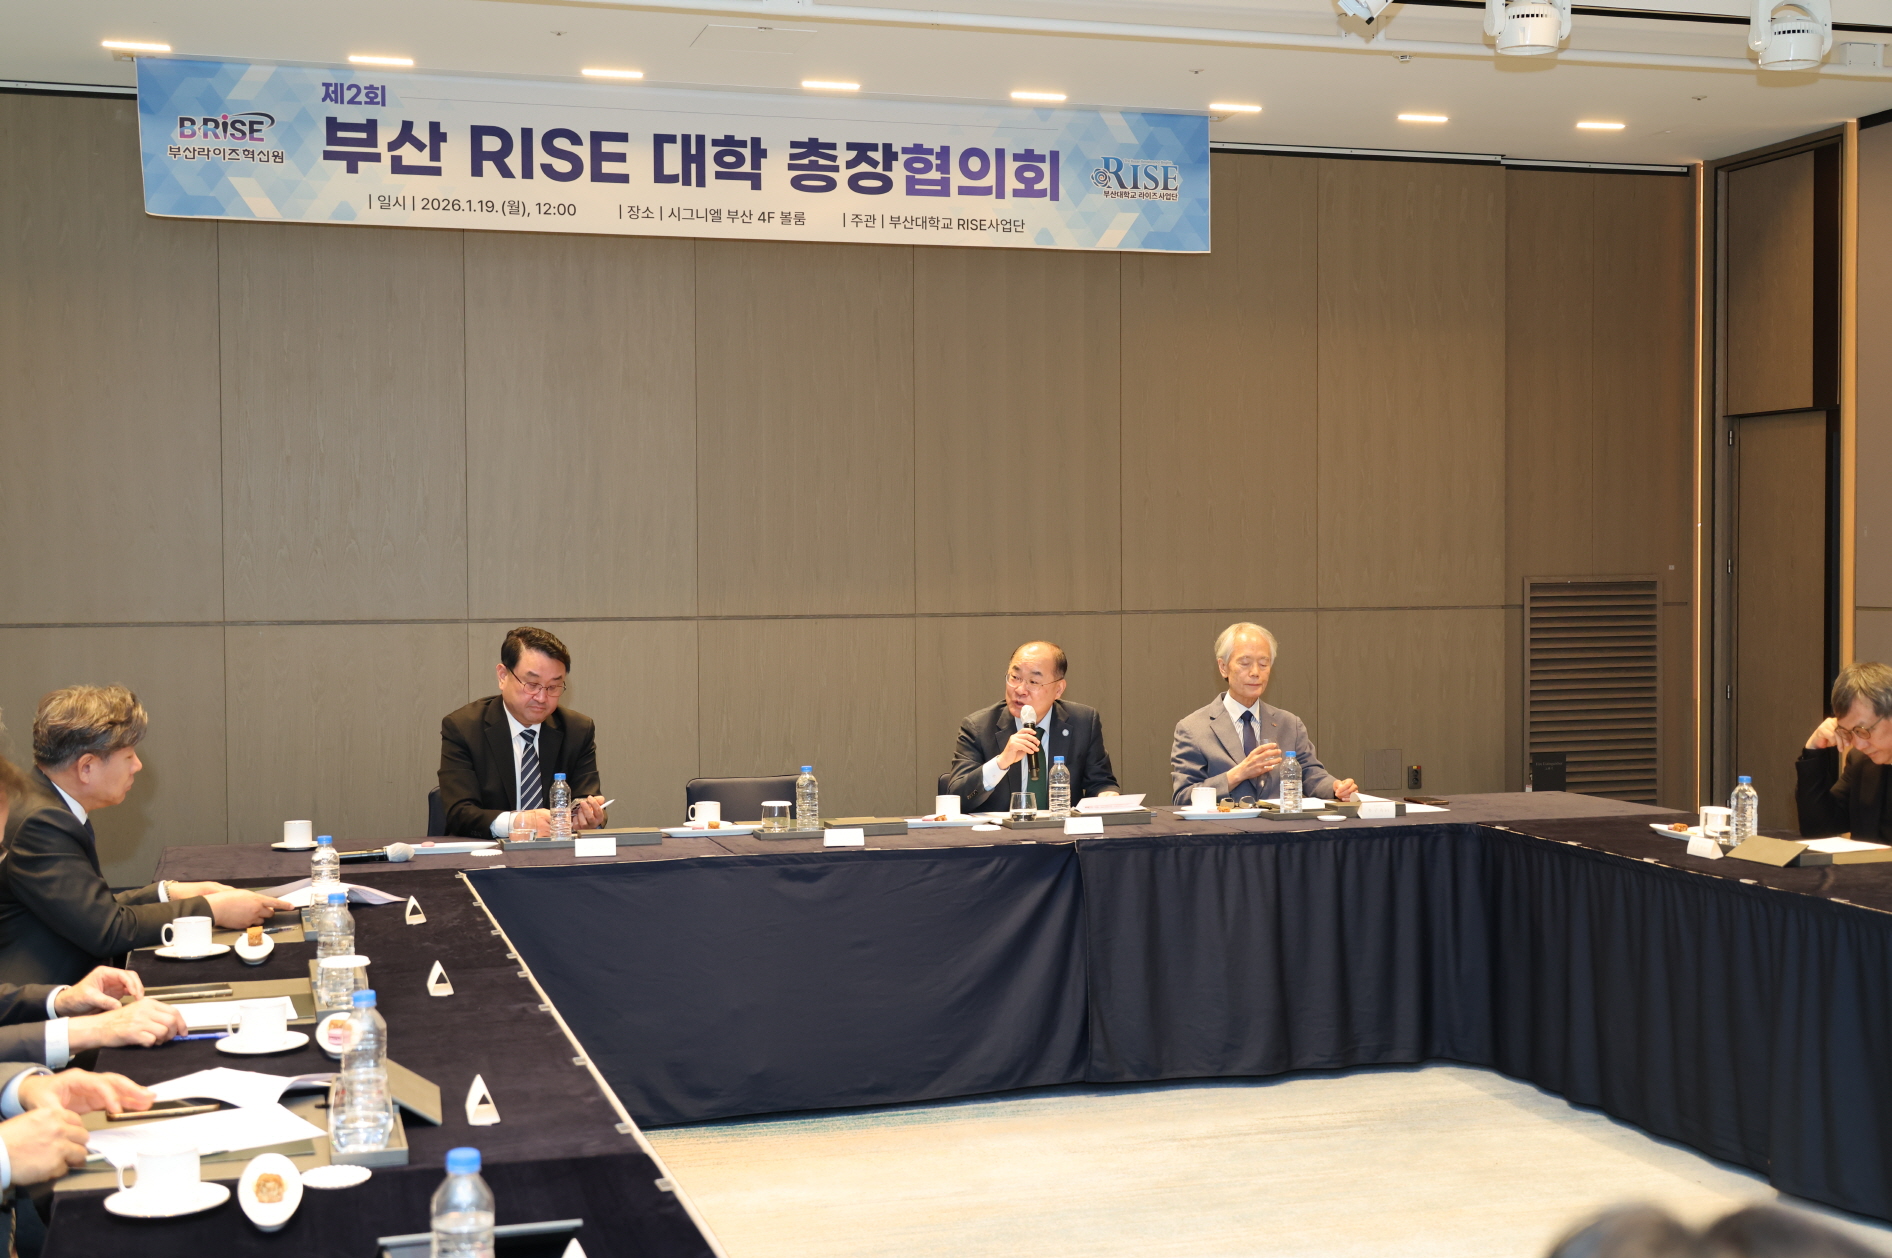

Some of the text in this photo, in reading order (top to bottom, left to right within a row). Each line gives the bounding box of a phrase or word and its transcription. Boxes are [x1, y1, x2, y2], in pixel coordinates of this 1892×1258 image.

[321, 82, 387, 107] 제2회
[168, 145, 284, 163] 부산라이즈혁신원
[323, 116, 1060, 202] 부산 RISE 대학 총장협의회
[1101, 156, 1179, 191] RISE
[1103, 190, 1137, 199] 부산대학교
[377, 195, 406, 210] 일시
[535, 202, 577, 216] 12:00
[627, 205, 806, 226] 장소 시그니엘 부산 4F 볼룸
[850, 213, 1026, 233] 주관 부산대학교 RISE사업단
